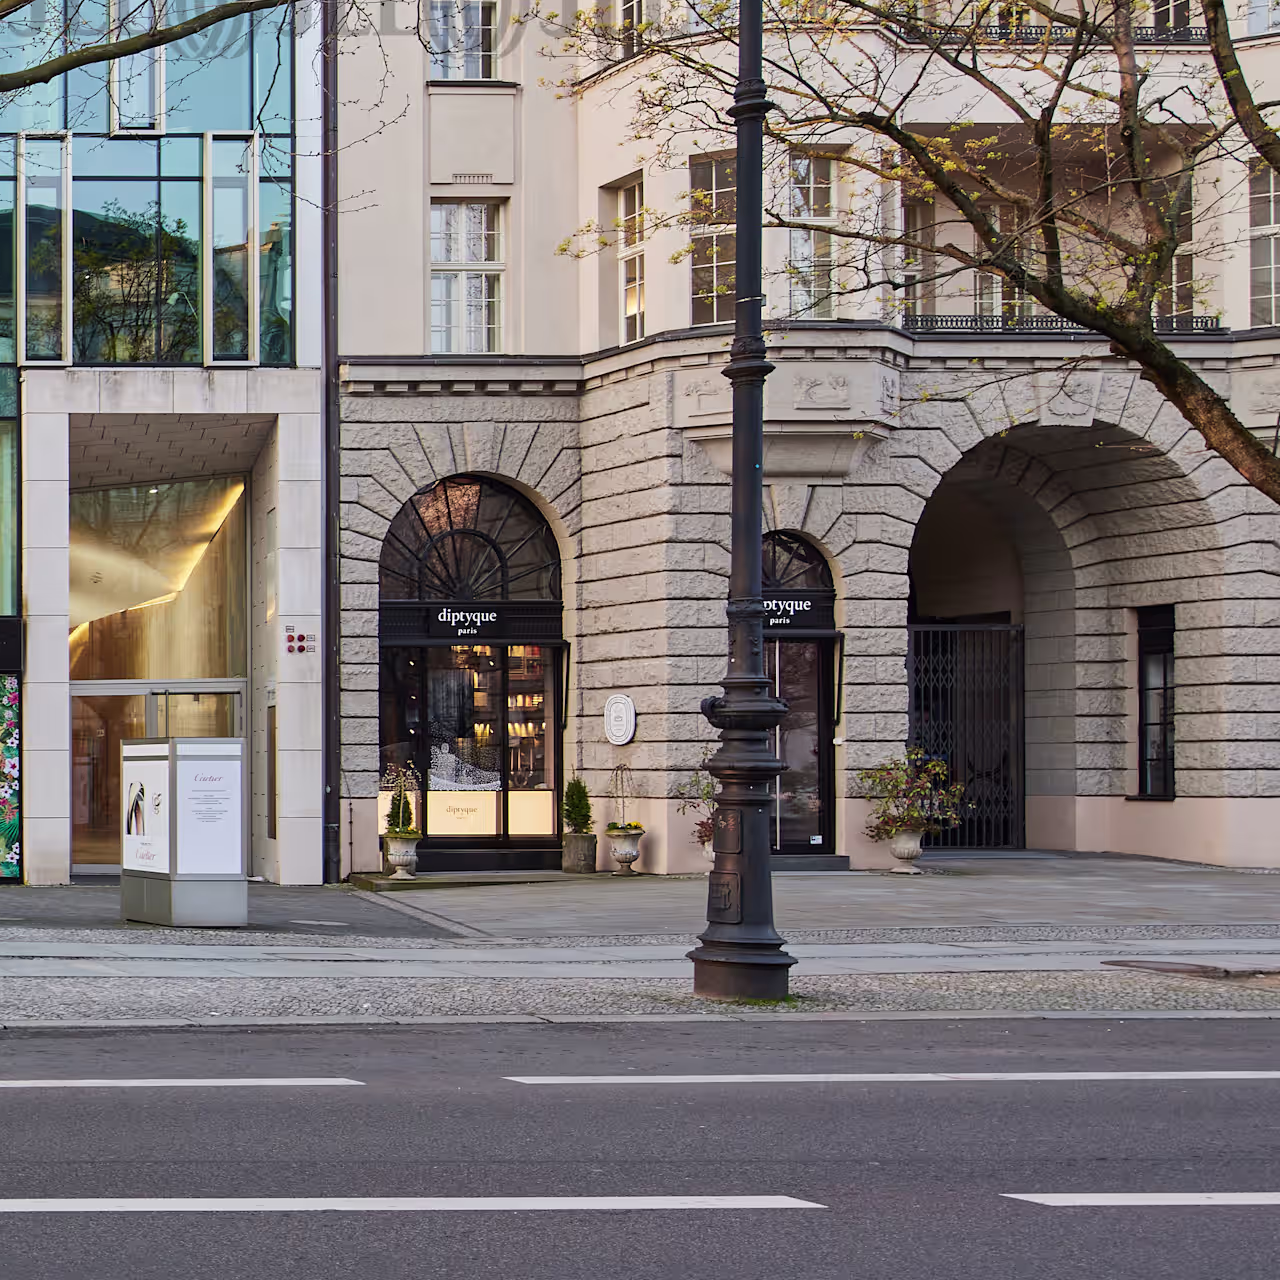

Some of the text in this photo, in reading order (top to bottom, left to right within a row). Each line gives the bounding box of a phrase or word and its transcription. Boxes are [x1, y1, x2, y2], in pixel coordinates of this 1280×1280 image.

[763, 599, 812, 615] ptyque
[438, 608, 497, 626] diptyque
[769, 617, 790, 625] paris
[458, 627, 477, 636] paris
[194, 773, 224, 782] Cartier
